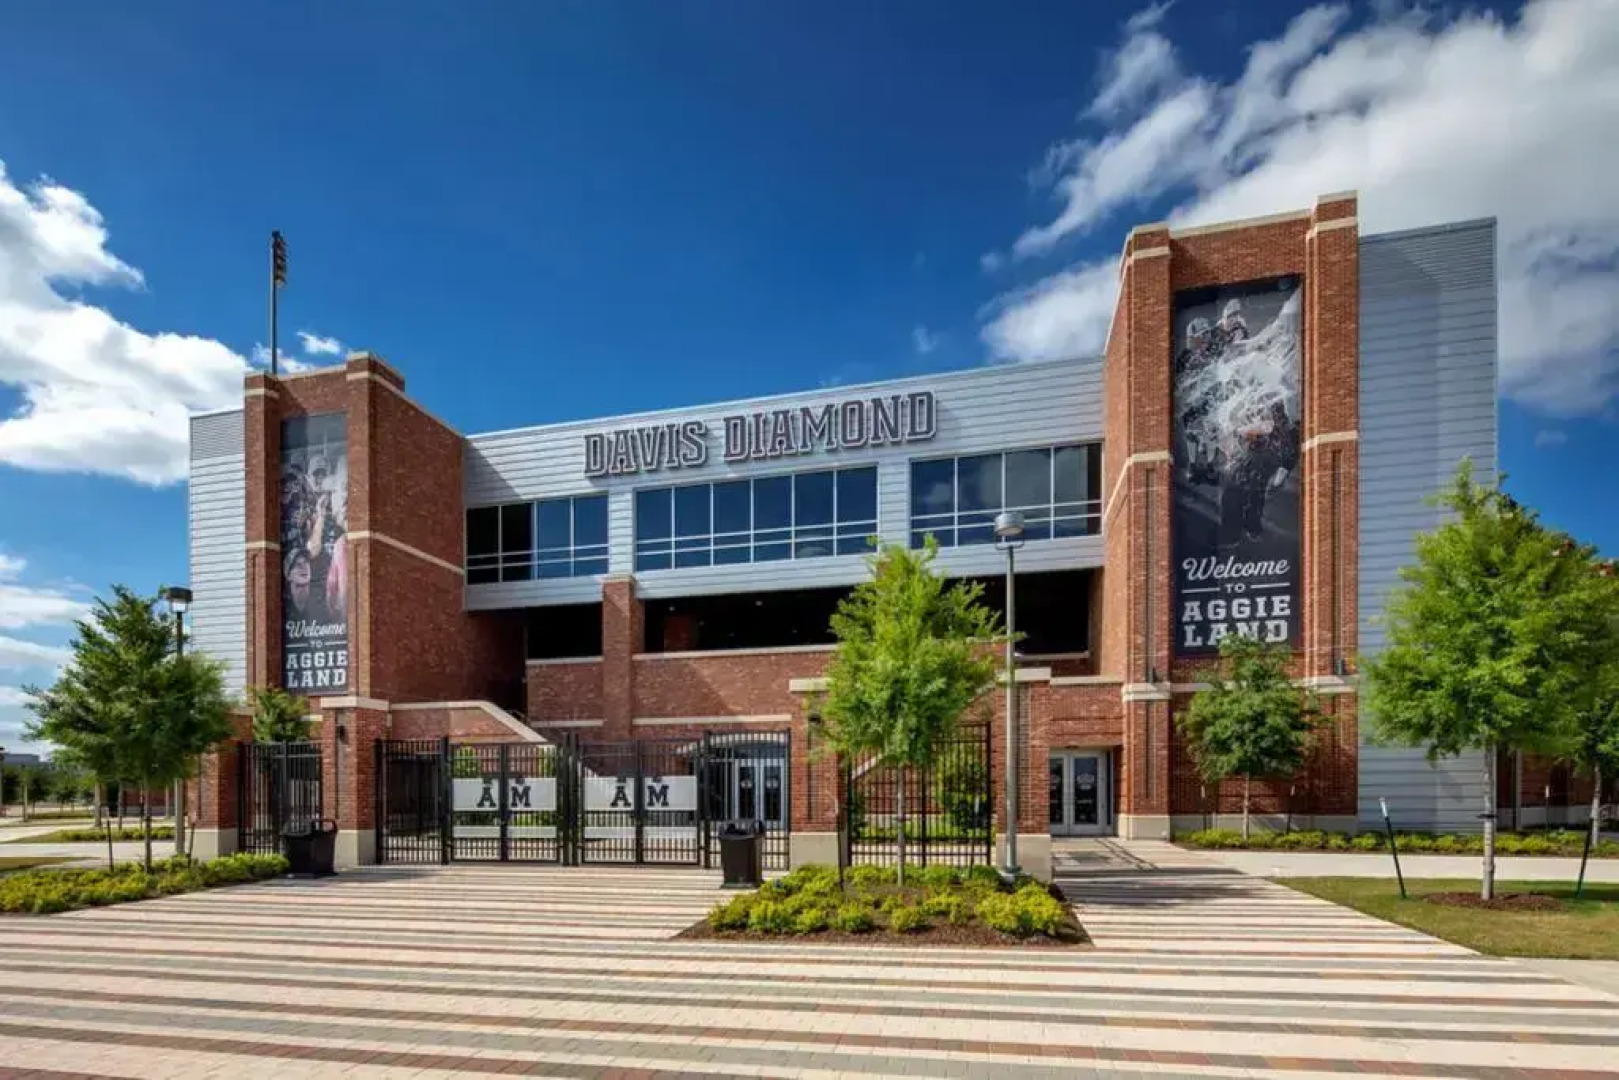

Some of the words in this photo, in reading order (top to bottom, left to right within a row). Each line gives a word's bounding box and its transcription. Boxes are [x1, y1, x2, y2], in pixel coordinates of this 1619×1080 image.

[584, 421, 709, 477] DAVIS
[723, 391, 938, 462] DIAMOND
[1182, 556, 1290, 581] Welcome
[1225, 583, 1245, 593] TO
[1182, 595, 1290, 622] AGGIE
[286, 620, 346, 638] Welcome
[1184, 620, 1287, 646] LAND
[310, 640, 322, 648] TO
[287, 651, 347, 669] AGGIE
[288, 669, 346, 688] LAND
